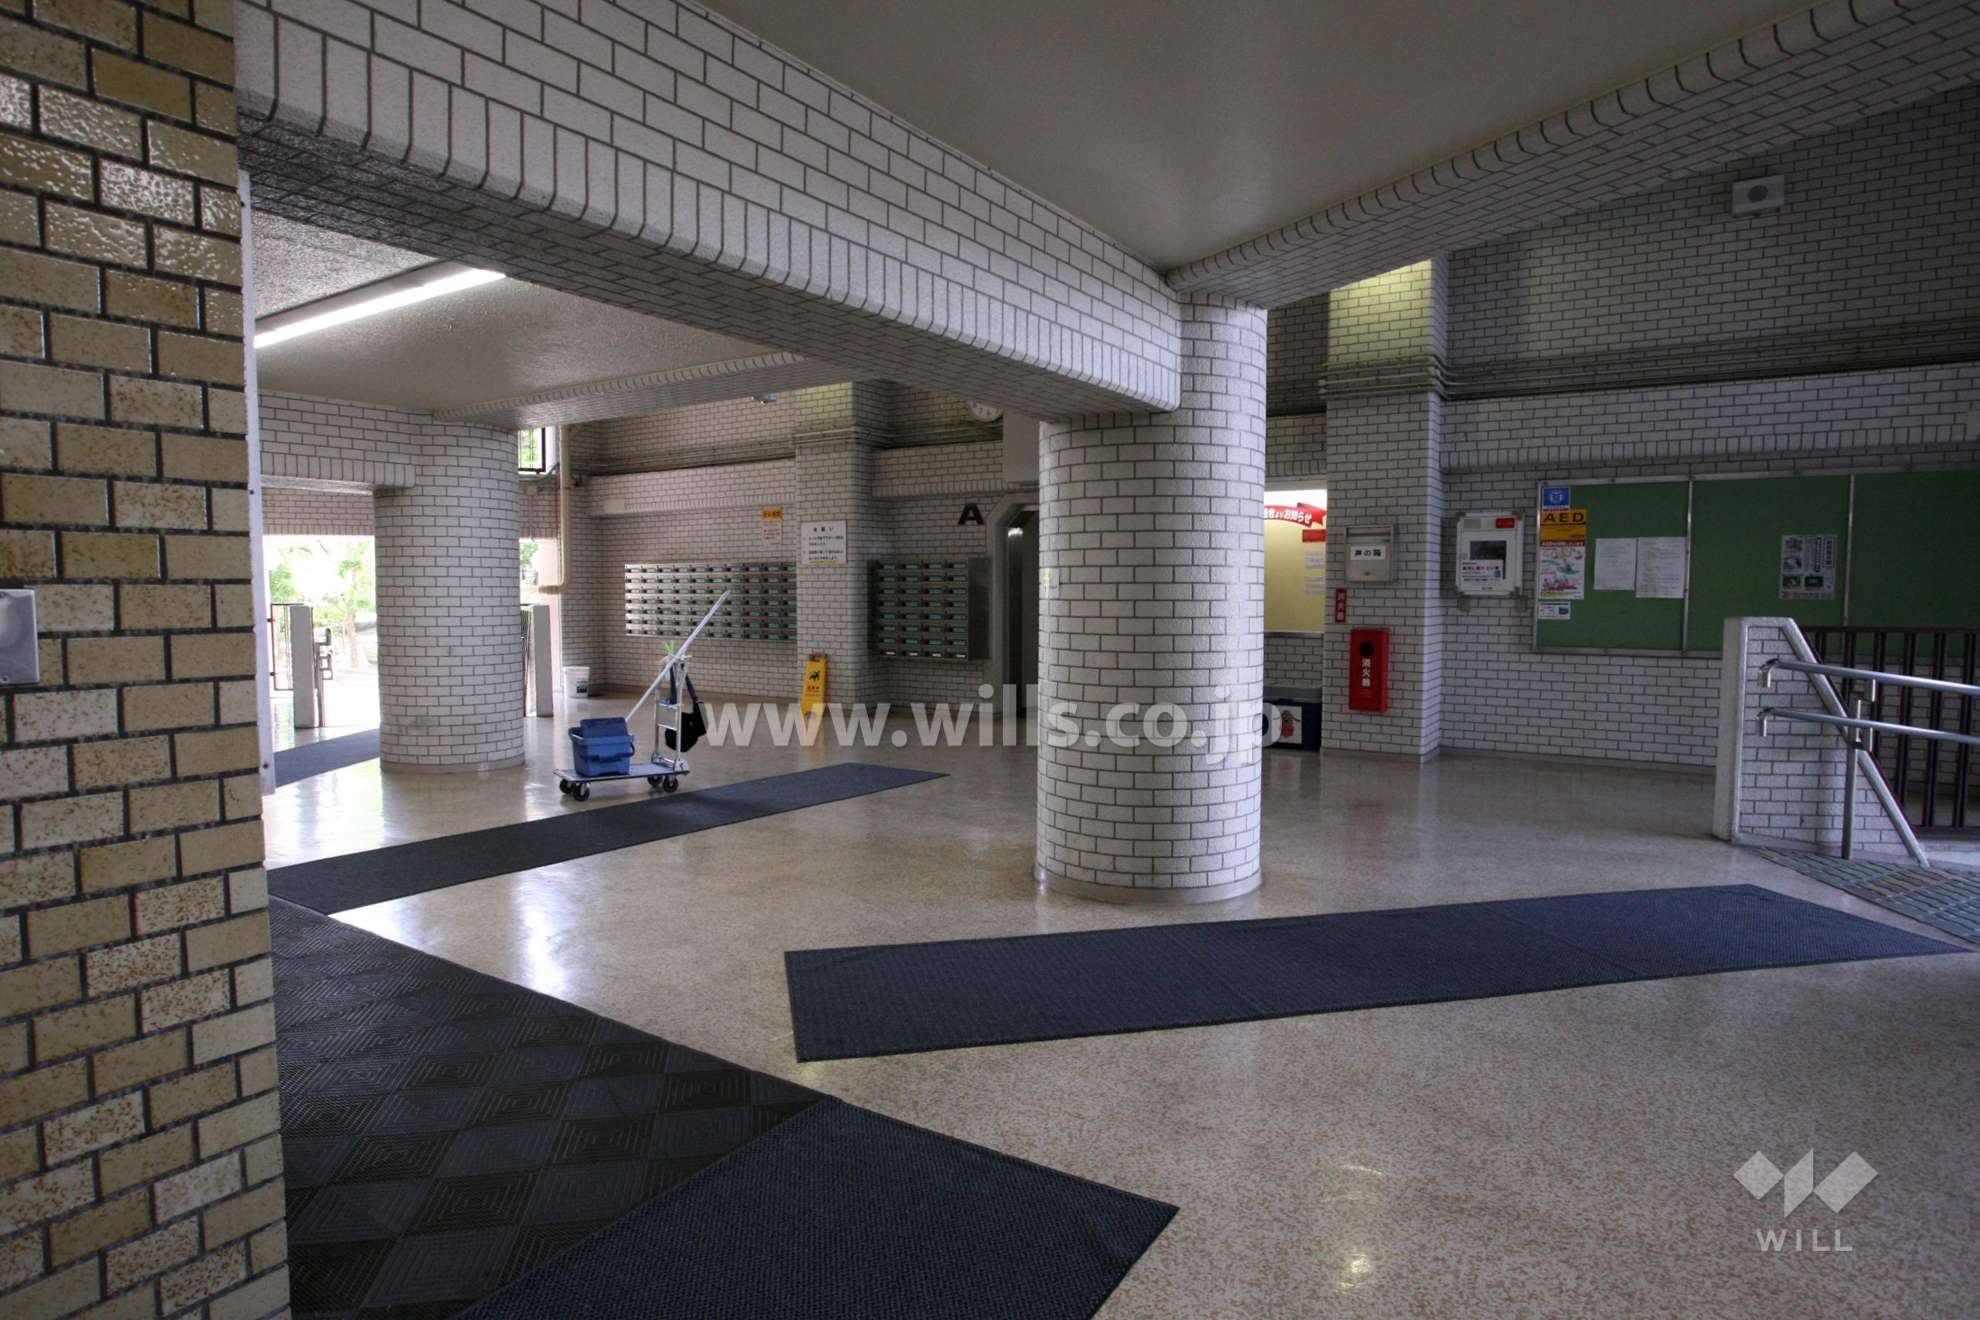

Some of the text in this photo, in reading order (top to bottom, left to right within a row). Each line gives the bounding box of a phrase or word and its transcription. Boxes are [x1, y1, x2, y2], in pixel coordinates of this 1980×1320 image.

[958, 502, 984, 525] A
[1544, 512, 1584, 523] AED
[1361, 658, 1372, 688] 消火器
